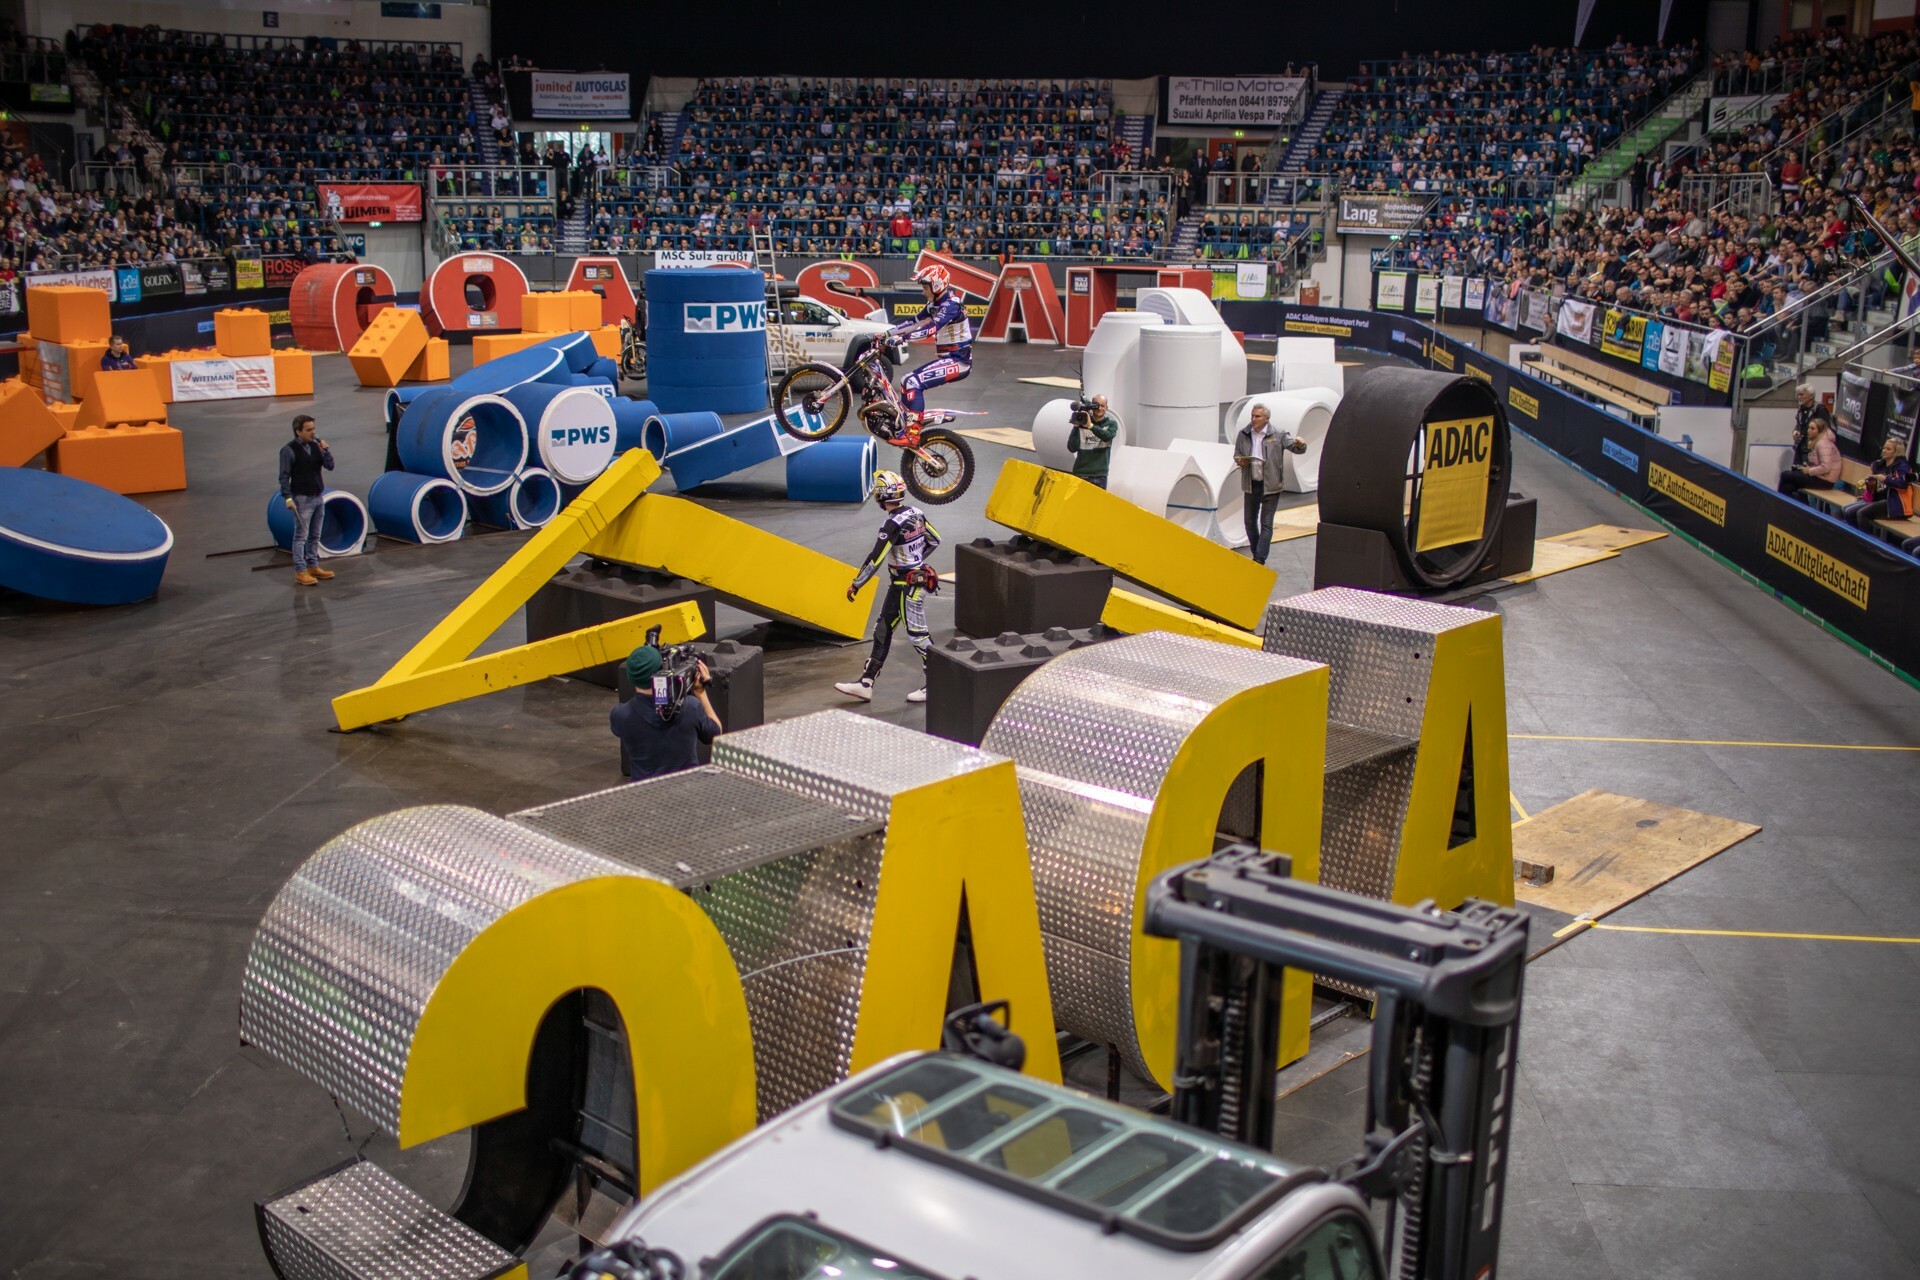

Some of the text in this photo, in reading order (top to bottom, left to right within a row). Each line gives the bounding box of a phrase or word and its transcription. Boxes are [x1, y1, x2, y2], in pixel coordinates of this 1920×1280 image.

[574, 80, 626, 93] AUTOGLAS
[1191, 79, 1284, 92] Thilo Moto
[1179, 95, 1294, 107] Pfaffenhofen 08441/89796
[1173, 108, 1204, 119] Suzuki
[1206, 109, 1236, 122] Aprilia
[1239, 109, 1265, 122] Vespa
[1343, 200, 1378, 225] Lang
[345, 235, 364, 246] WC
[661, 251, 748, 262] MSC Sulz grüßt
[896, 305, 924, 314] ADAC
[716, 304, 767, 331] PWS
[1285, 312, 1370, 328] ADAC Südbayern Motorsport Portal
[1286, 322, 1351, 335] motorsport-suedbayern.de
[192, 374, 235, 383] WITTMANN
[567, 426, 610, 446] PWS
[1427, 422, 1489, 470] ADAC
[1649, 467, 1724, 526] ADAC Autofinanzierung
[1767, 530, 1867, 604] ADAC Mitgliedschaft
